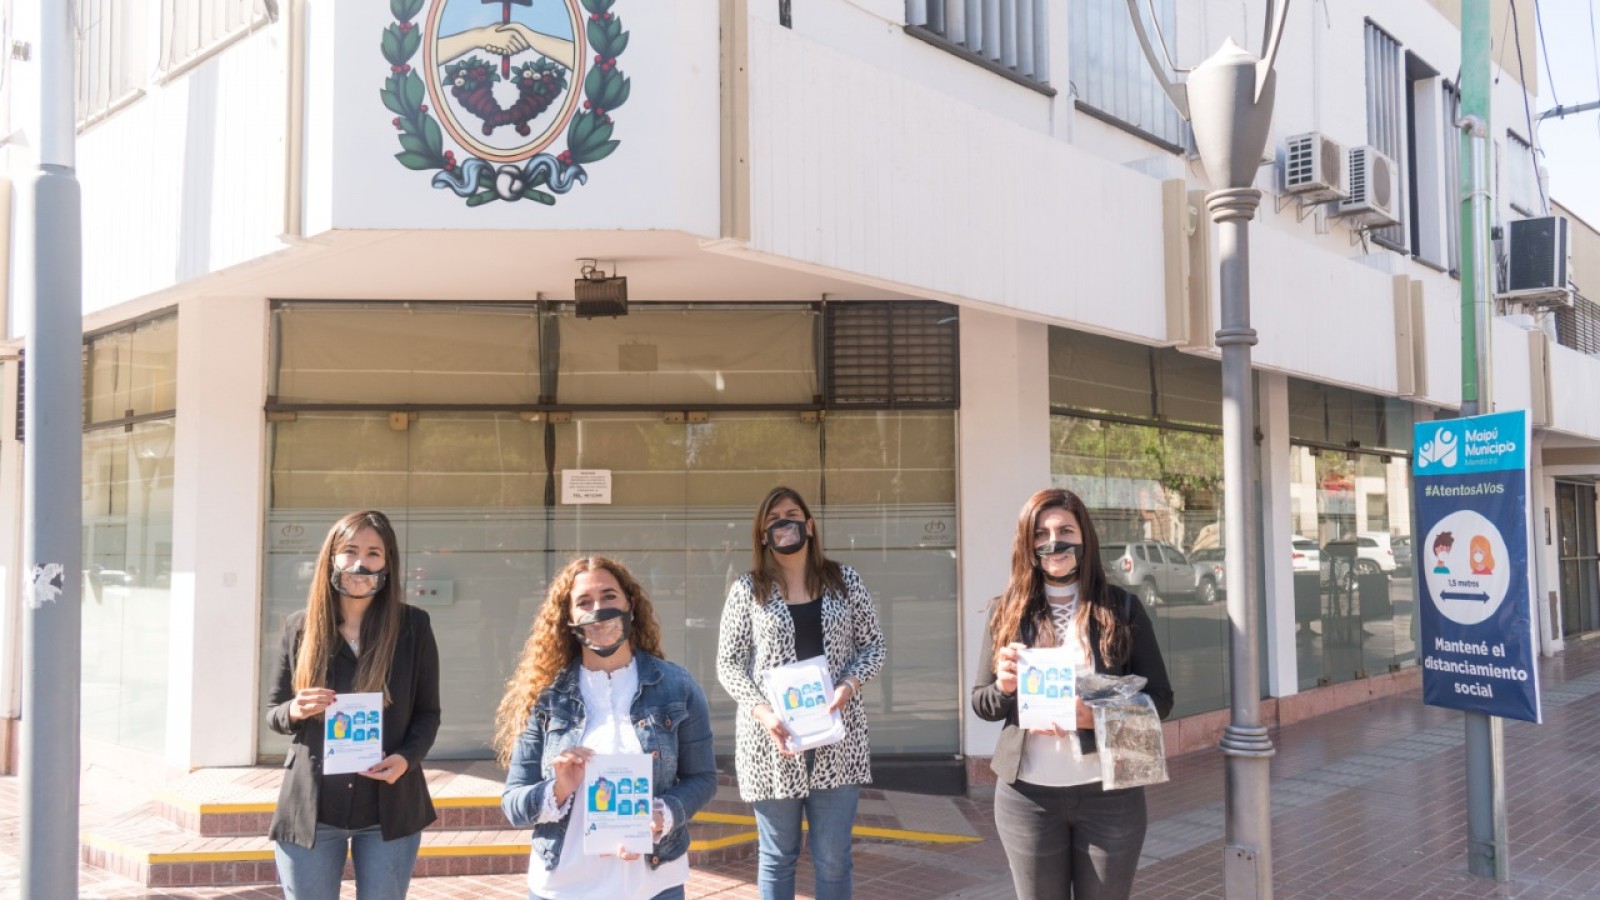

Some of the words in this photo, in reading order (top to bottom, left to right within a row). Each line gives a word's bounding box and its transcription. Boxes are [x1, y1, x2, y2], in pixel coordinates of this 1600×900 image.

[1465, 427, 1498, 443] Maipú
[1465, 441, 1516, 456] Municipio
[1425, 482, 1505, 497] #AtentosAVos
[1458, 580, 1479, 588] metros
[1435, 637, 1489, 656] Mantené
[1492, 643, 1506, 657] el
[1424, 656, 1528, 681] distanciamiento
[1454, 681, 1493, 698] social
